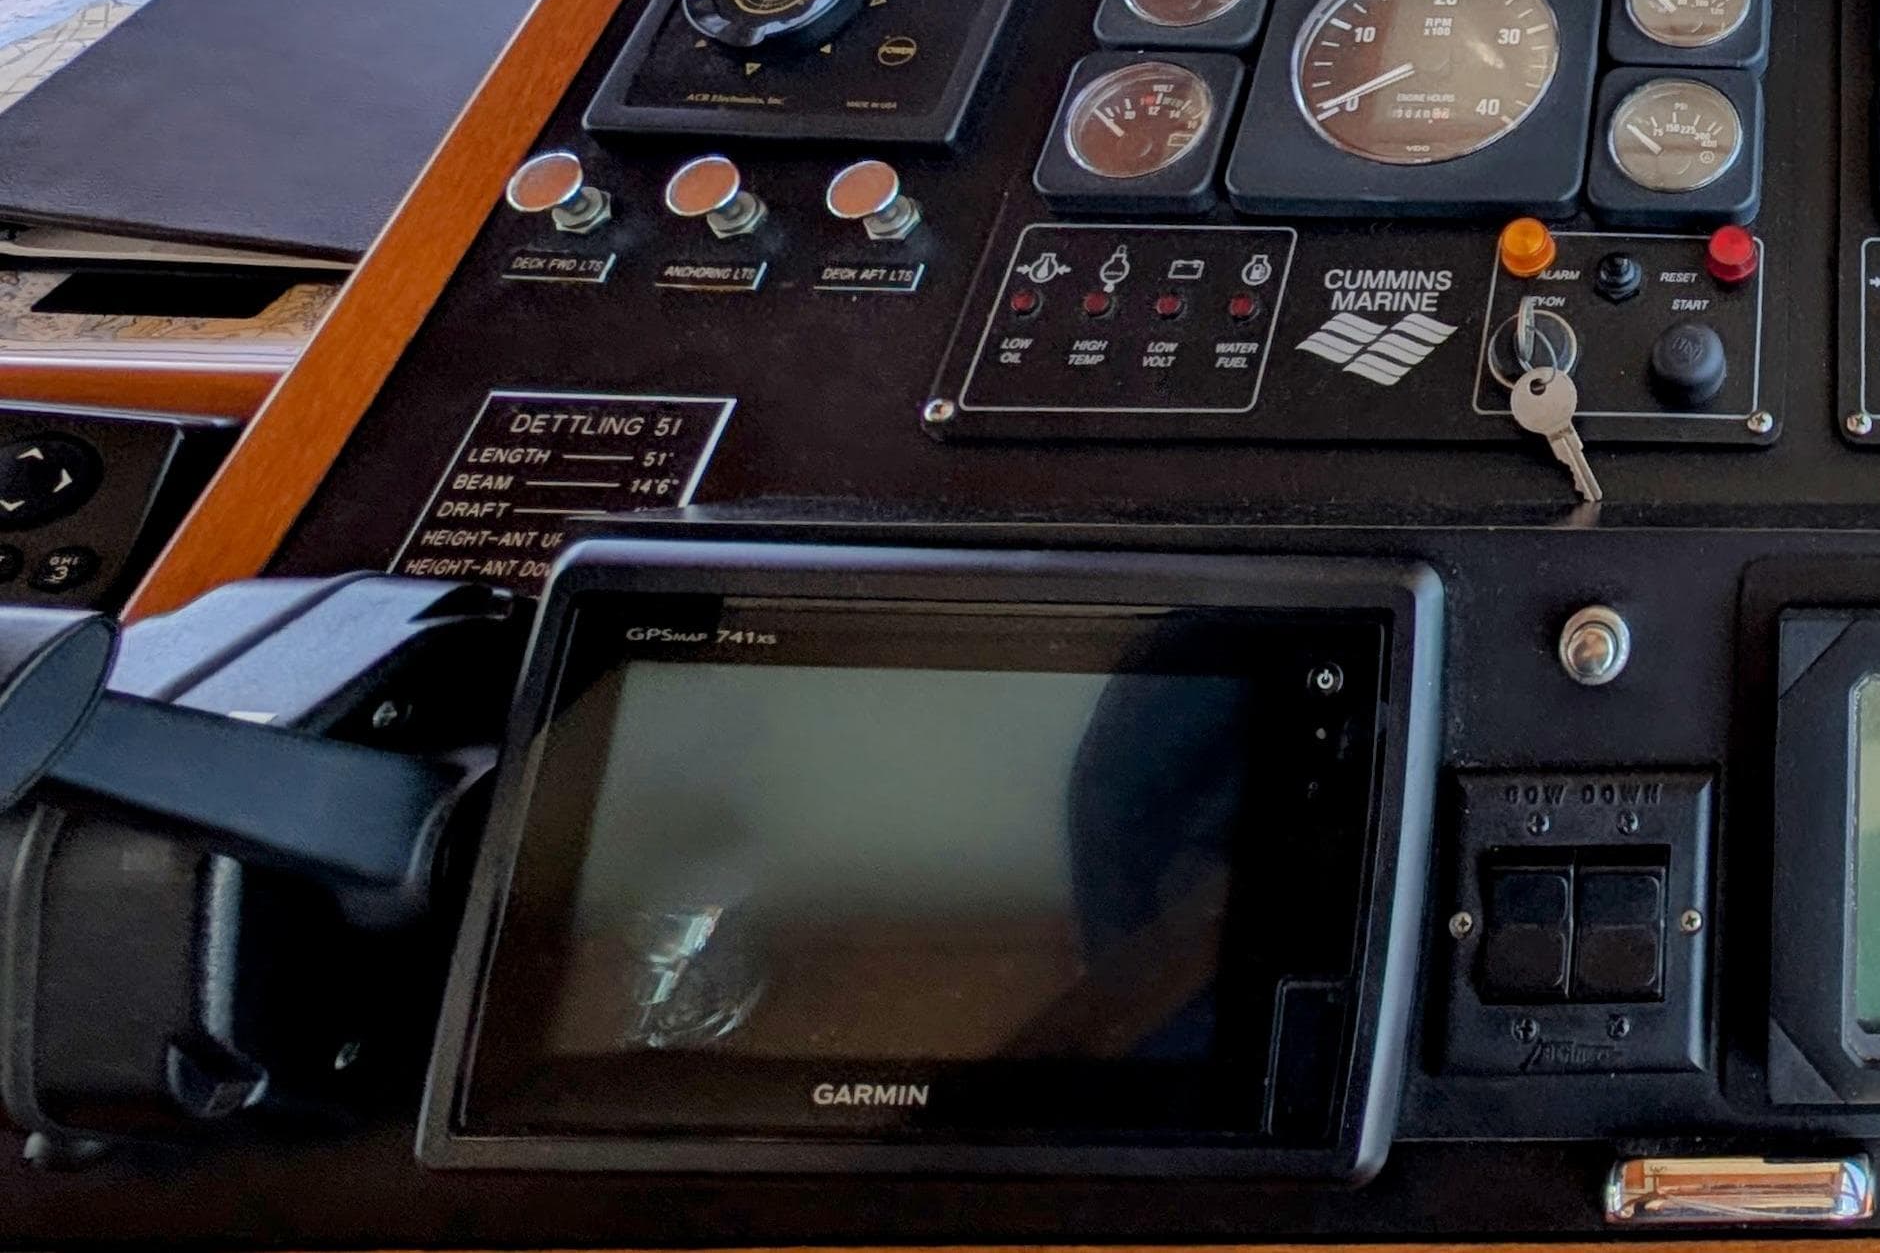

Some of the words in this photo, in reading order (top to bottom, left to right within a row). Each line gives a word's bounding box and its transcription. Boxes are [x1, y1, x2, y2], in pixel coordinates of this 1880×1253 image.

[1425, 18, 1452, 28] RPM
[1355, 27, 1376, 43] 10
[1498, 29, 1521, 44] 30
[1148, 107, 1160, 116] 12
[1476, 99, 1500, 116] 40
[1653, 128, 1664, 136] 75
[1665, 123, 1680, 133] 150
[1680, 126, 1696, 134] 225
[512, 255, 545, 270] DECK
[579, 258, 604, 272] LTS
[733, 268, 757, 280] LTS
[822, 267, 856, 280] DECK
[860, 269, 885, 281] AFT
[888, 269, 914, 282] LTS
[1536, 269, 1580, 281] ALARM
[1660, 272, 1698, 284] RESET
[1324, 270, 1453, 292] CUMMINS
[1331, 292, 1438, 312] MARINE
[1672, 299, 1709, 311] START
[1001, 337, 1032, 350] LOW
[1072, 340, 1107, 352] HIGH
[1147, 342, 1178, 354] LOW
[1215, 343, 1259, 355] WATER
[999, 352, 1022, 364] OIL
[1067, 353, 1106, 366] TEMP
[1142, 355, 1176, 368] VOLT
[1215, 356, 1249, 368] FUEL
[511, 414, 645, 436] DETTLING
[655, 417, 682, 436] 51
[467, 448, 552, 464] LENGTH
[453, 474, 514, 490] BEAM
[436, 502, 511, 517] DRAFT
[421, 530, 537, 547] HEIGHT-ANT
[405, 558, 519, 576] HEIGHT-ANT
[626, 627, 708, 642] GPSMAP
[813, 1084, 929, 1105] GARMIN
